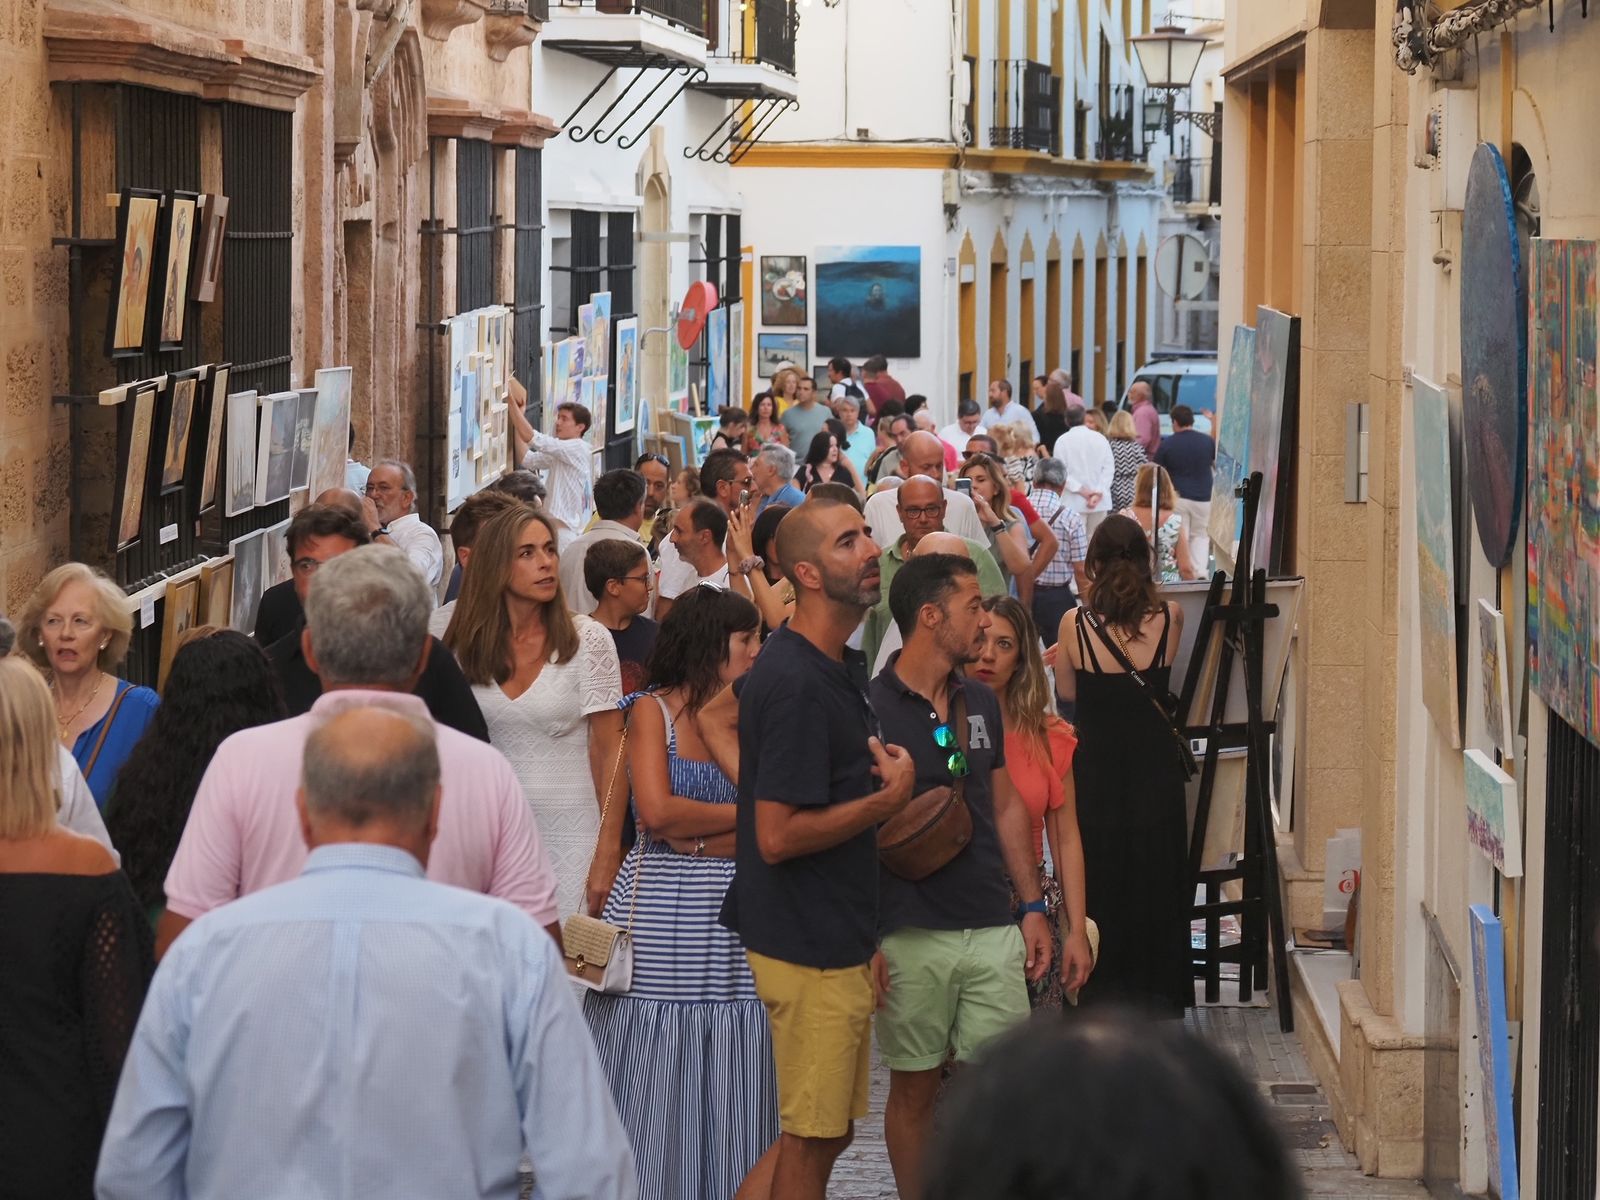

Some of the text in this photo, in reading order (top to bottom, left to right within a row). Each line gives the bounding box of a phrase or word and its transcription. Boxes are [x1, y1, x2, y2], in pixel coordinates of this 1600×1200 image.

[1085, 610, 1099, 628] Canon
[1130, 670, 1146, 687] Canon
[966, 714, 992, 750] A
